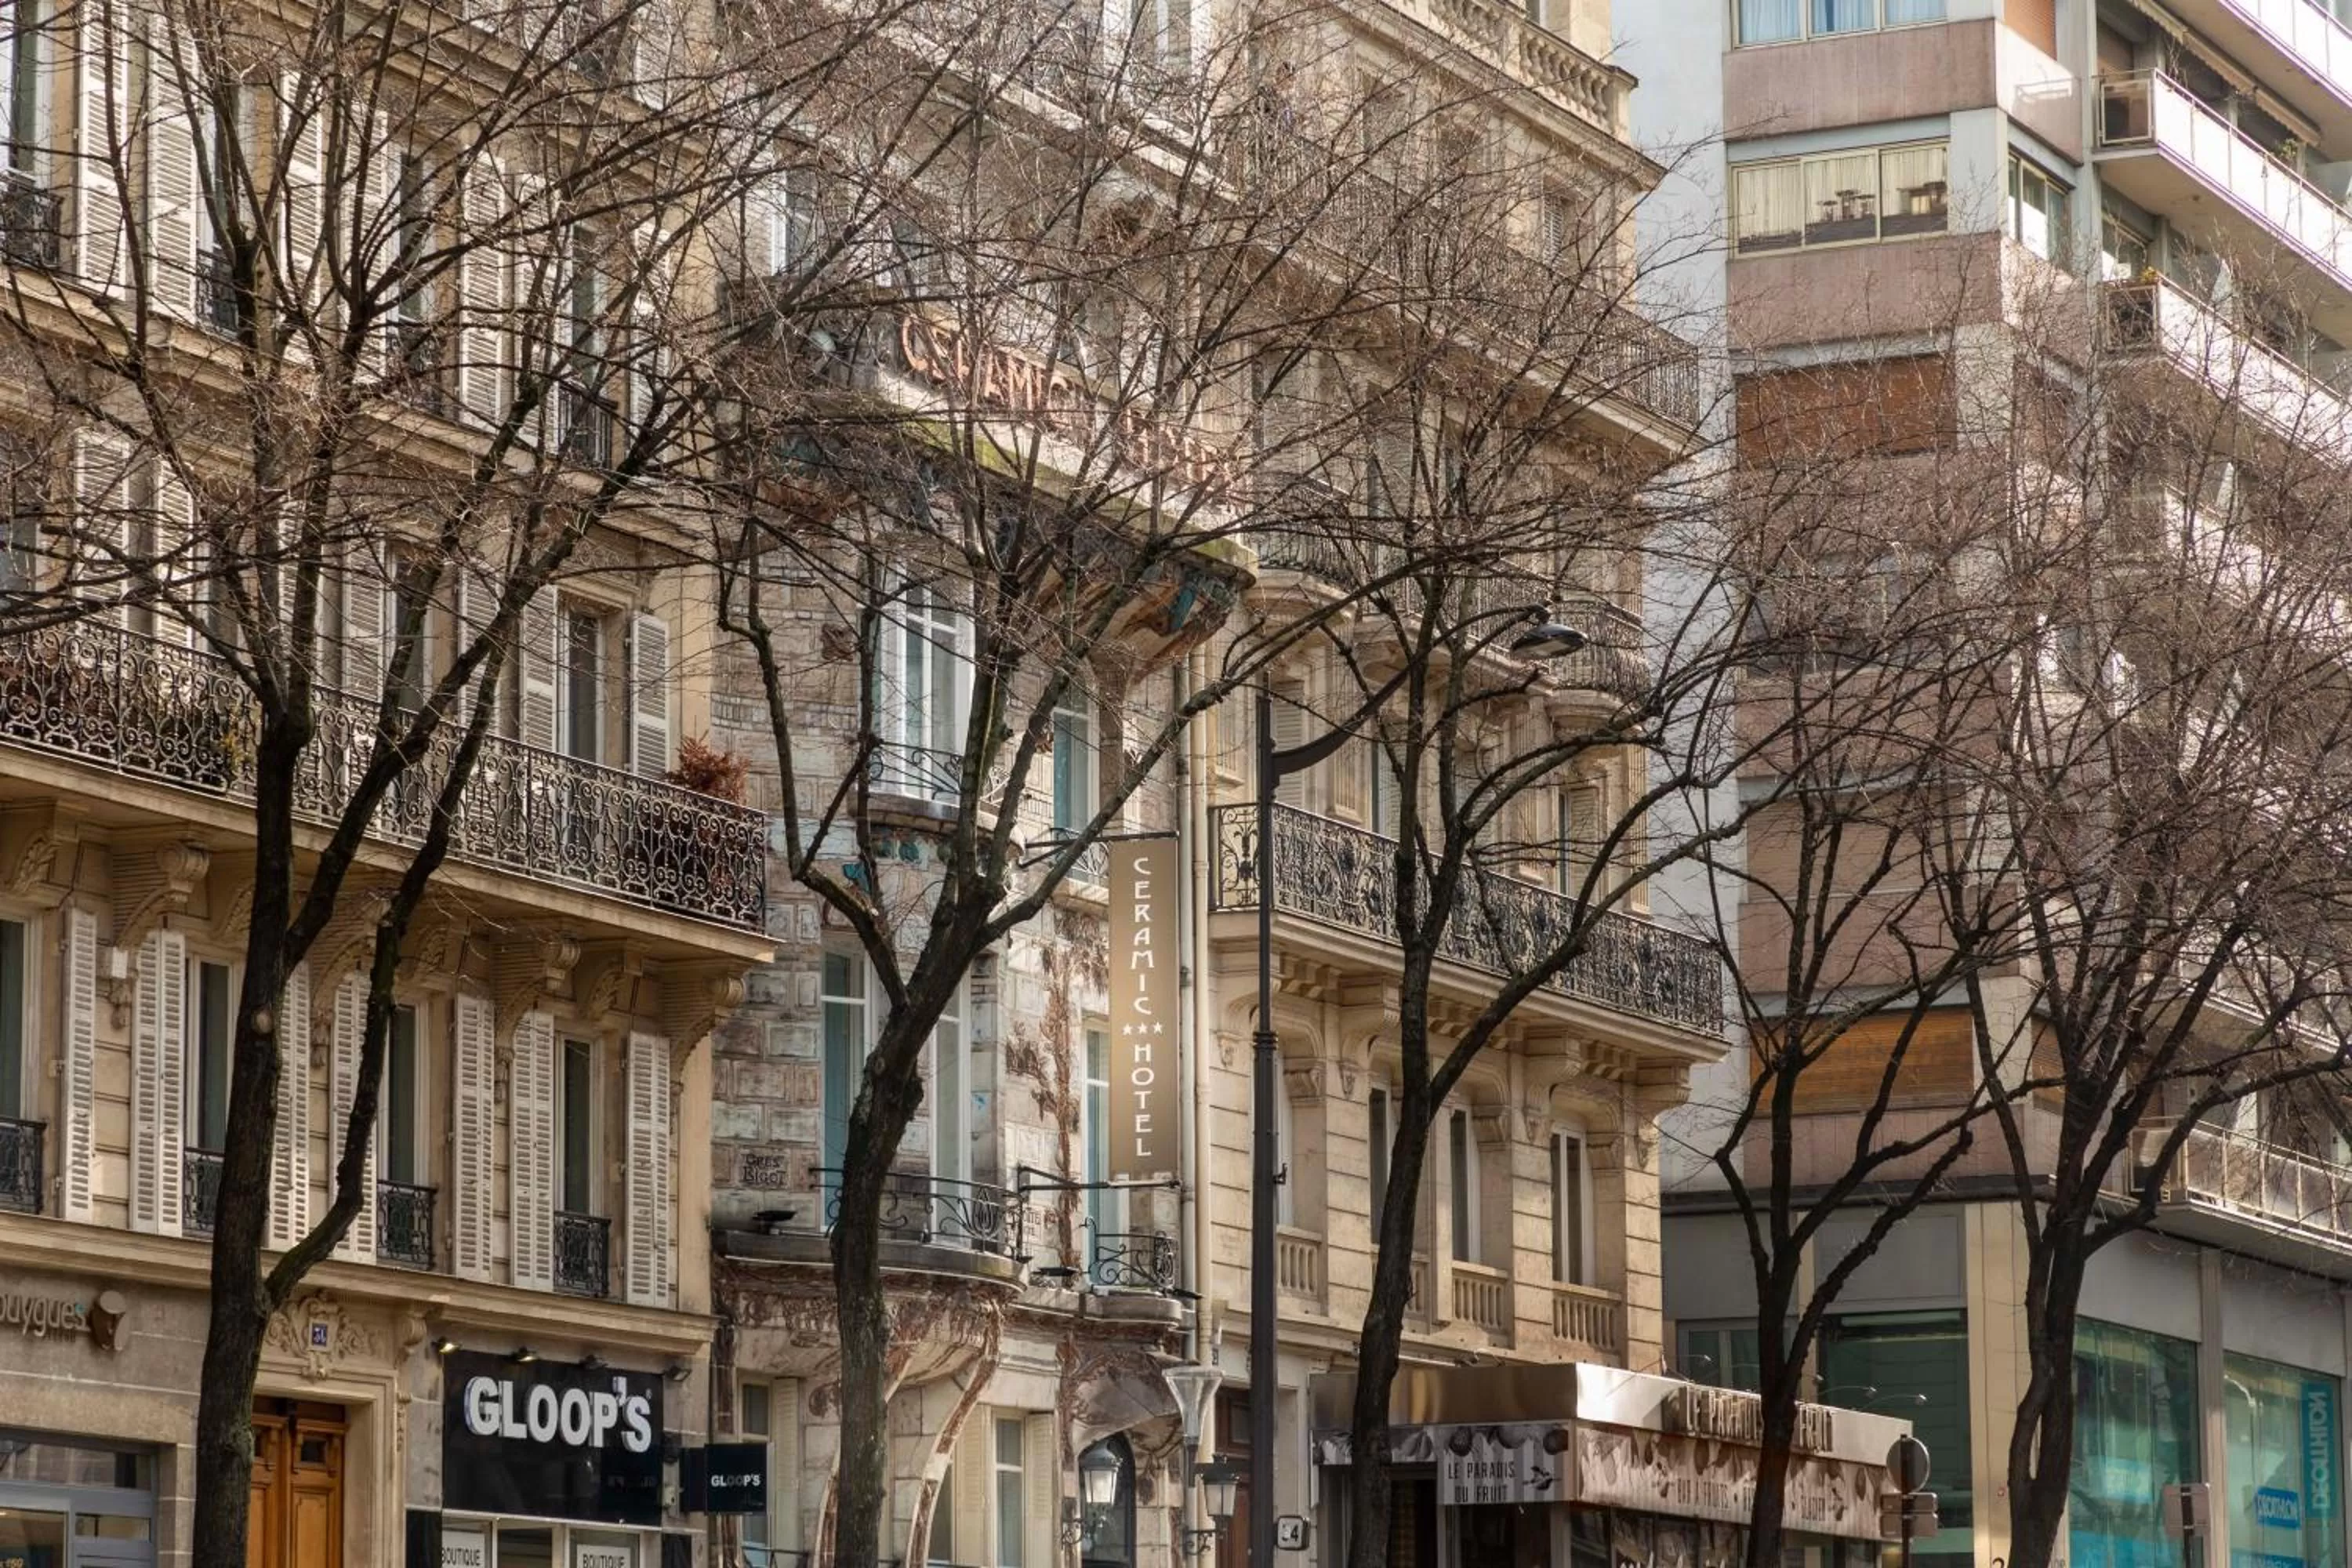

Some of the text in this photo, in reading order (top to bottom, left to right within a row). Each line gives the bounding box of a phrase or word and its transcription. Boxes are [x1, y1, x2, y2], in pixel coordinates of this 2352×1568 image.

[1130, 857, 1156, 1157] CERAMIC HOTEL
[464, 1376, 652, 1453] GLOOP'S
[1708, 1389, 1762, 1440] PARADI
[1448, 1461, 1515, 1479] LE PARADIS
[711, 1474, 760, 1487] GLOOP'S
[1454, 1485, 1508, 1502] DU FRUIT
[441, 1547, 480, 1566] BOUTIQUE
[583, 1553, 625, 1568] BOUTIQUE
